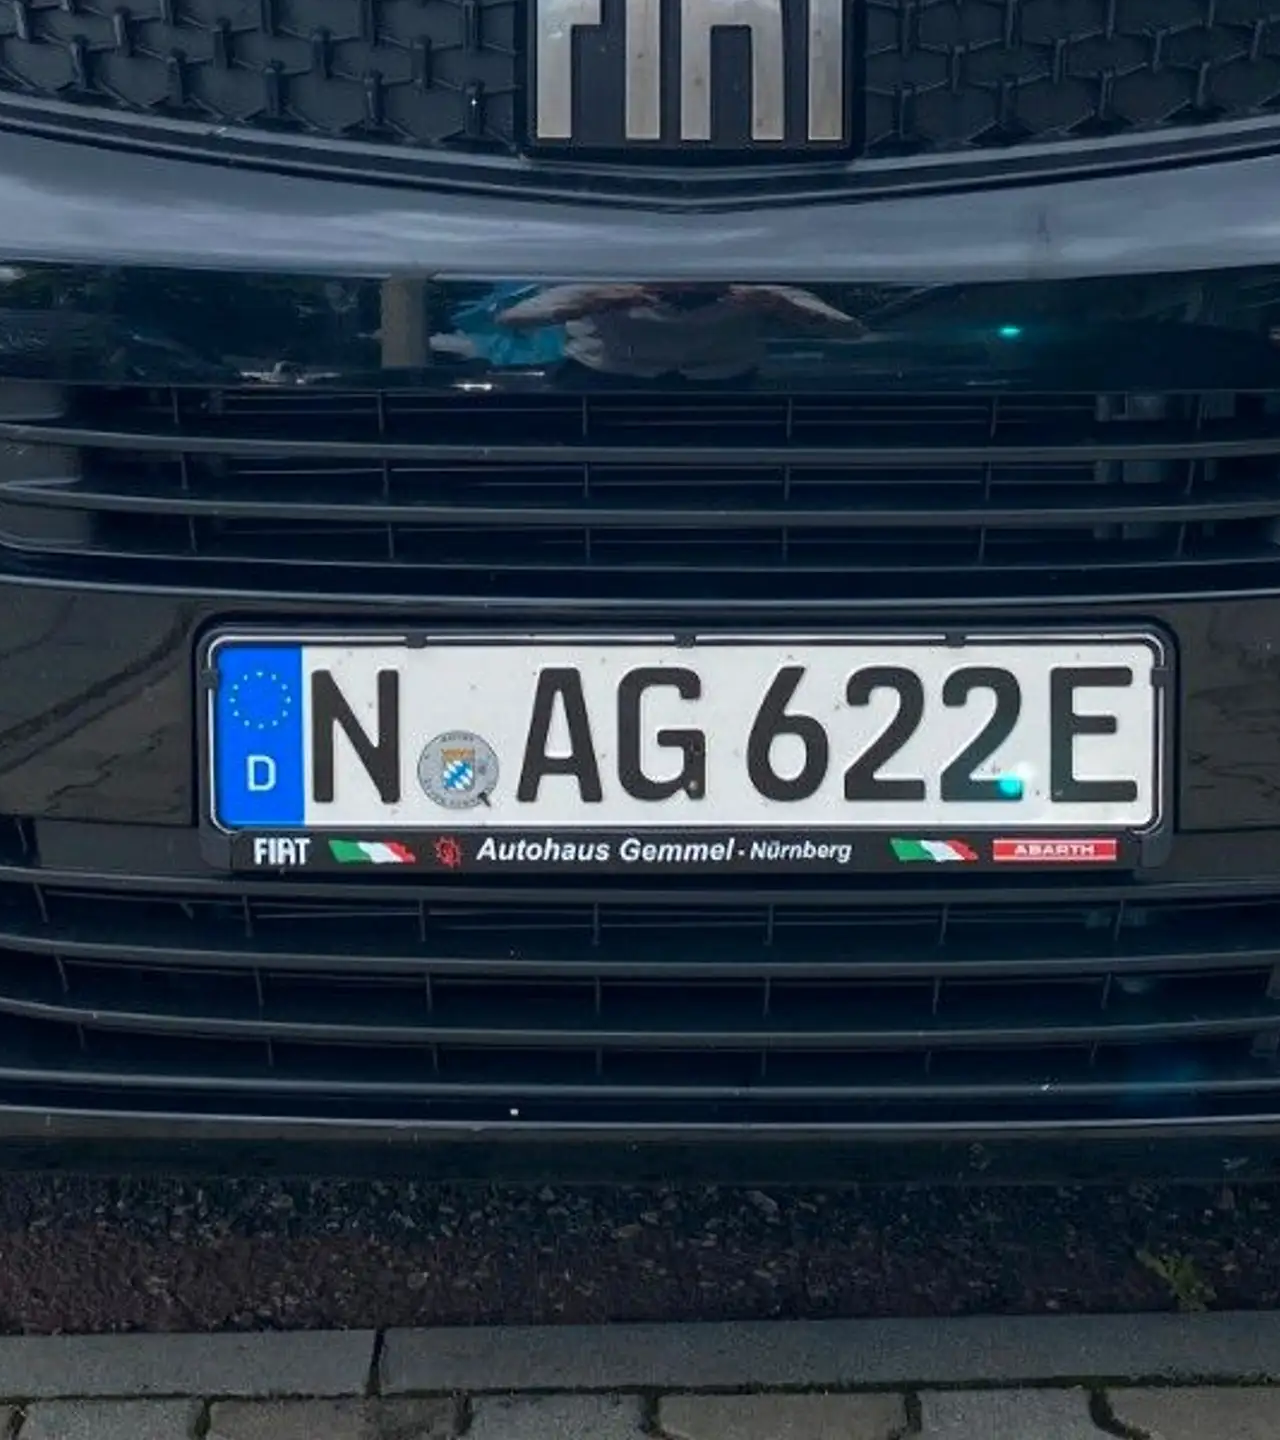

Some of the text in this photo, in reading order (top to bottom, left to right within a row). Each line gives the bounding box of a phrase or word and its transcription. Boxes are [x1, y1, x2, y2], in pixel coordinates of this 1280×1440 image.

[311, 669, 401, 804] N
[515, 667, 706, 804] AG
[747, 666, 1138, 803] 622E
[247, 755, 276, 792] D
[253, 837, 311, 865] FIAT
[476, 837, 610, 861] Autohaus
[619, 837, 735, 861] Gemmel
[749, 840, 853, 863] Nürnberg
[1013, 843, 1096, 856] ABARTH
